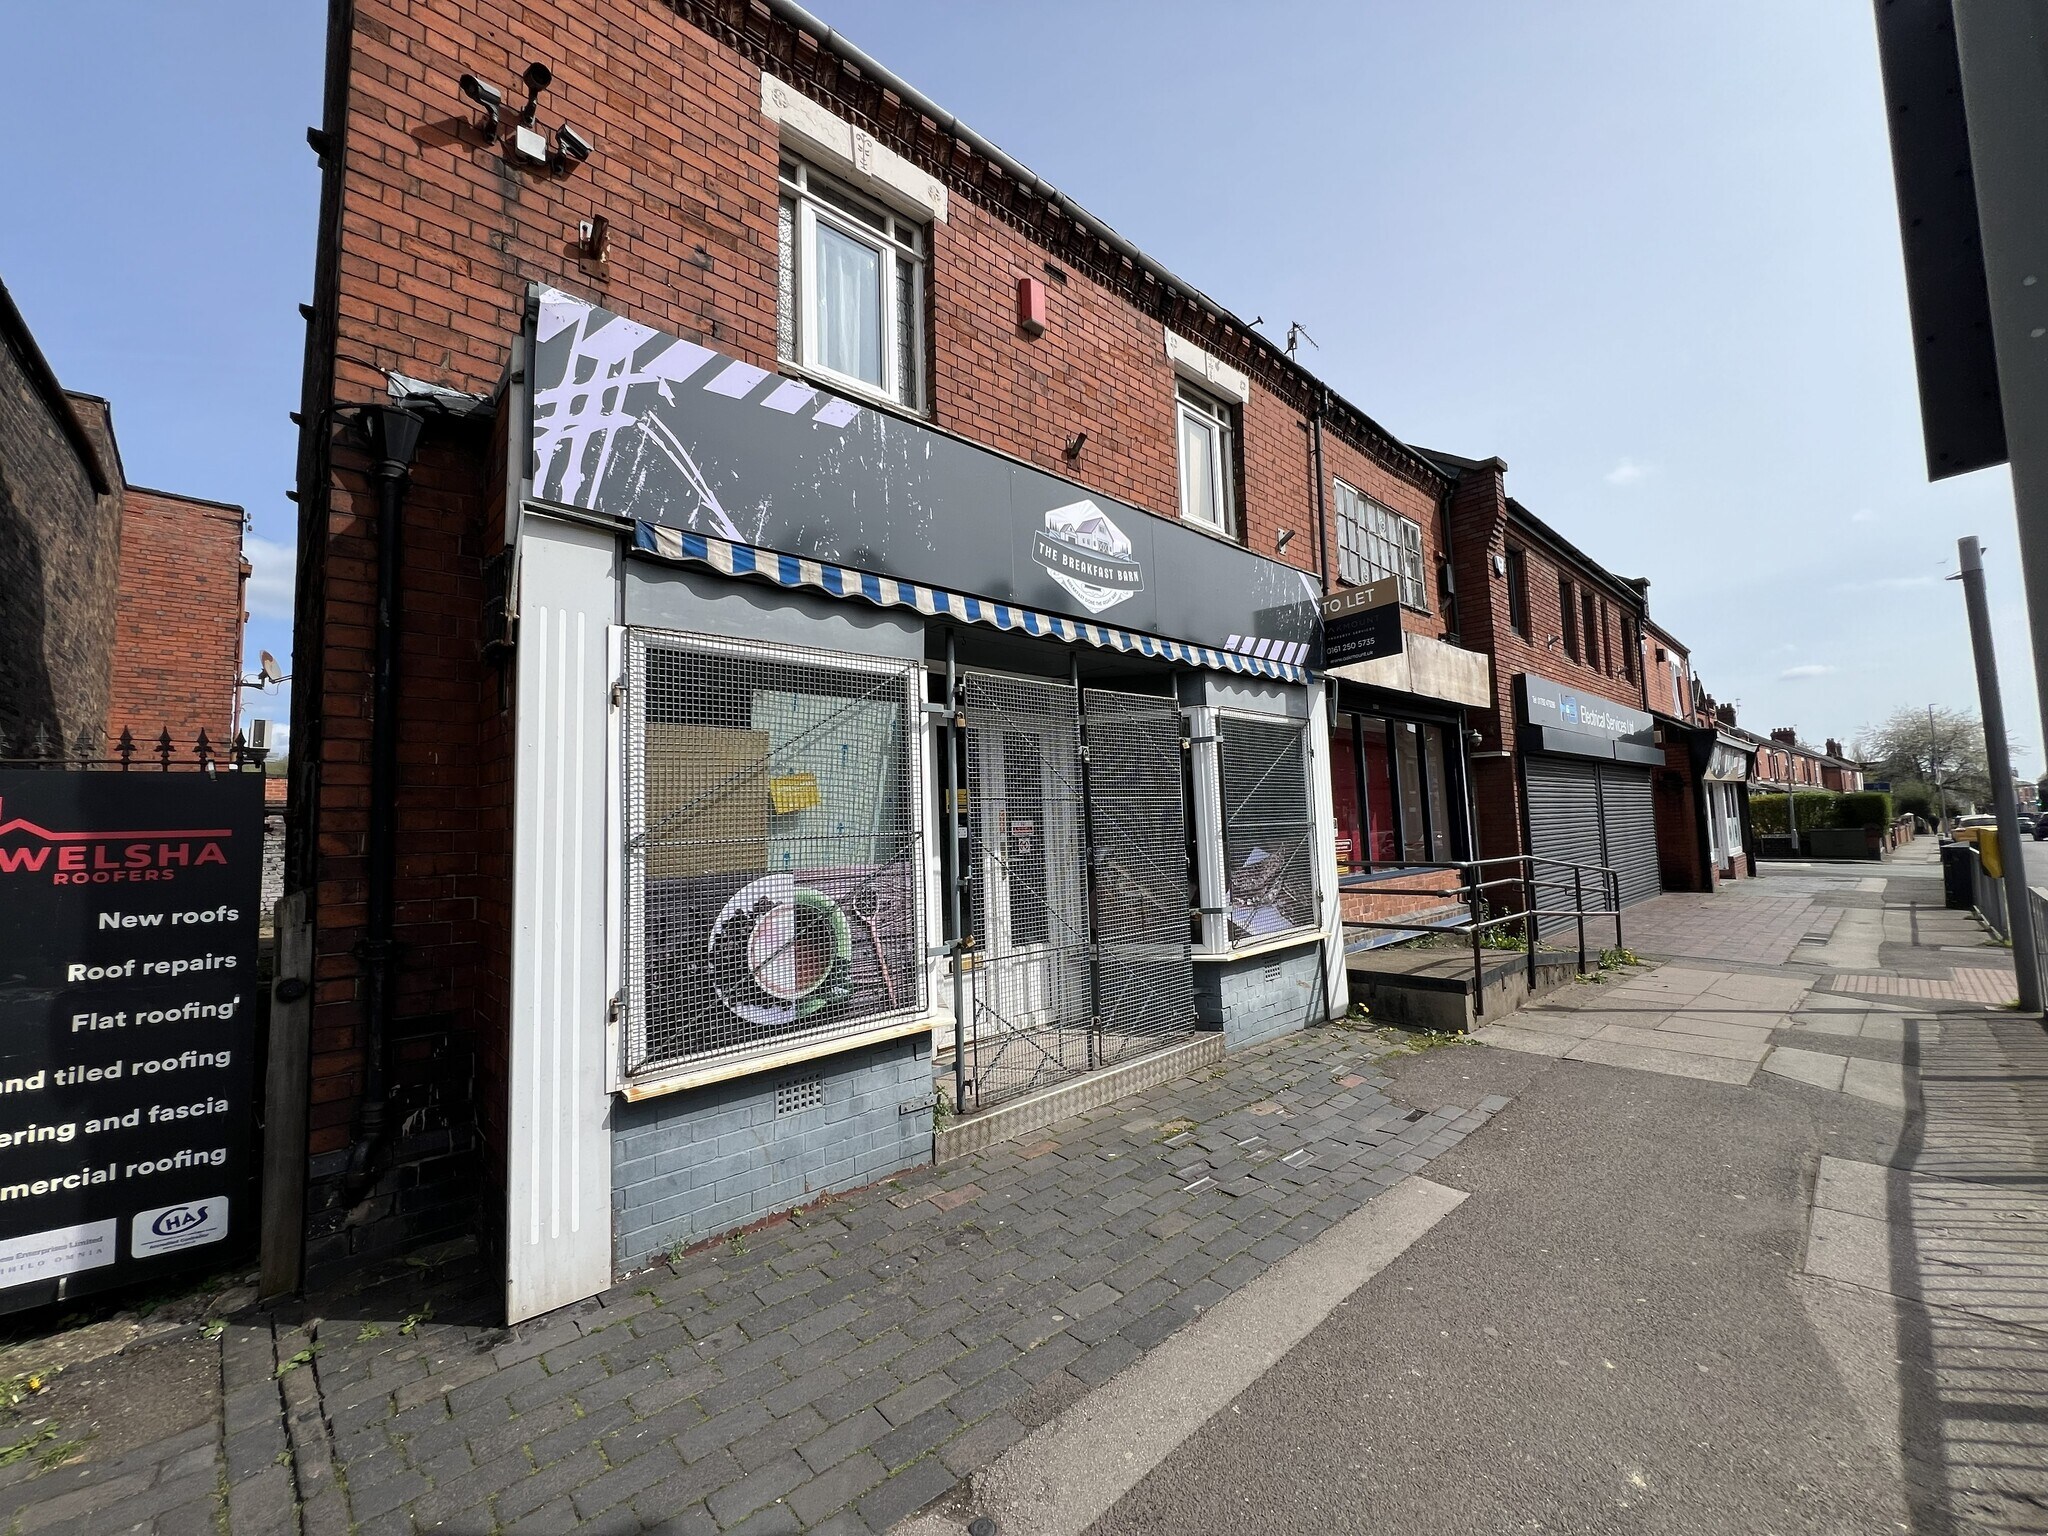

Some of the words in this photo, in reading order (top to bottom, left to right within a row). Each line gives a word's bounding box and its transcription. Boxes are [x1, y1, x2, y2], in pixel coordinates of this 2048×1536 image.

[1039, 542, 1058, 561] THE
[1062, 553, 1114, 580] BREAKFAST
[1117, 570, 1140, 582] BARN
[1322, 599, 1341, 614] TO
[1346, 588, 1375, 608] LET
[1327, 614, 1379, 634] AKMOUNT
[1342, 642, 1356, 652] 250
[1357, 637, 1375, 648] 5735
[1580, 704, 1605, 729] Electrical
[1605, 712, 1627, 734] Services
[0, 842, 228, 873] WELSHA
[53, 869, 175, 885] ROOFERS
[99, 911, 163, 930] New
[171, 905, 240, 925] roofs
[67, 959, 136, 982] Roof
[143, 953, 237, 977] repairs
[71, 1011, 127, 1033] Flat
[135, 1002, 235, 1026] roofing
[0, 1070, 45, 1094] nd
[54, 1060, 123, 1086] tiled
[131, 1050, 231, 1077] roofing
[0, 1123, 76, 1148] ering
[85, 1108, 140, 1134] and
[148, 1096, 229, 1124] fascia
[0, 1163, 117, 1201] mercial
[125, 1147, 227, 1179] roofing
[152, 1206, 209, 1236] CHAS
[16, 1244, 68, 1259] Enterprises
[69, 1236, 103, 1249] Limited
[54, 1248, 103, 1263] OMNIA
